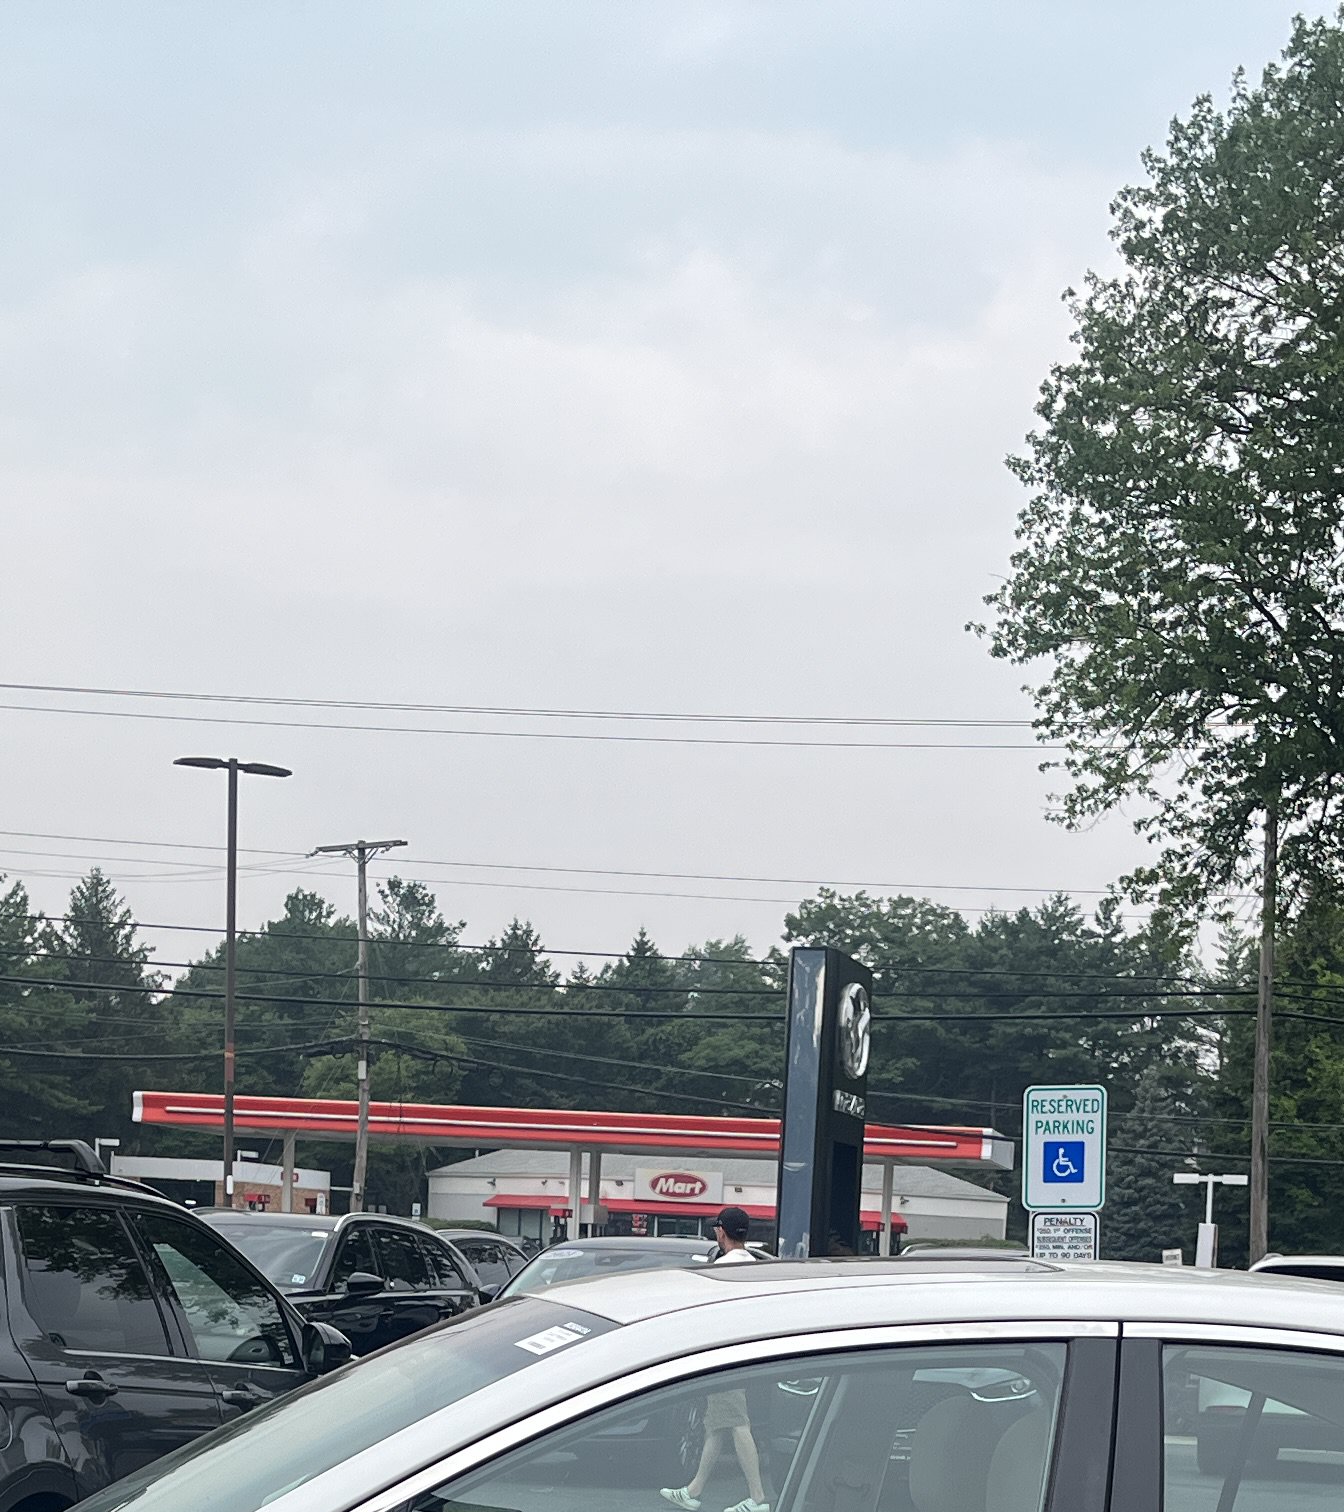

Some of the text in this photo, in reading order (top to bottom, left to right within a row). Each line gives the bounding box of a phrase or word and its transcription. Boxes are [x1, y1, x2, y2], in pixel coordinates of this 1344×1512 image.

[1031, 1099, 1100, 1114] RESERVED
[1035, 1119, 1095, 1135] PARKING
[655, 1177, 703, 1195] Mart
[1043, 1217, 1086, 1226] PENALTY
[1063, 1227, 1093, 1235] OFFENSE
